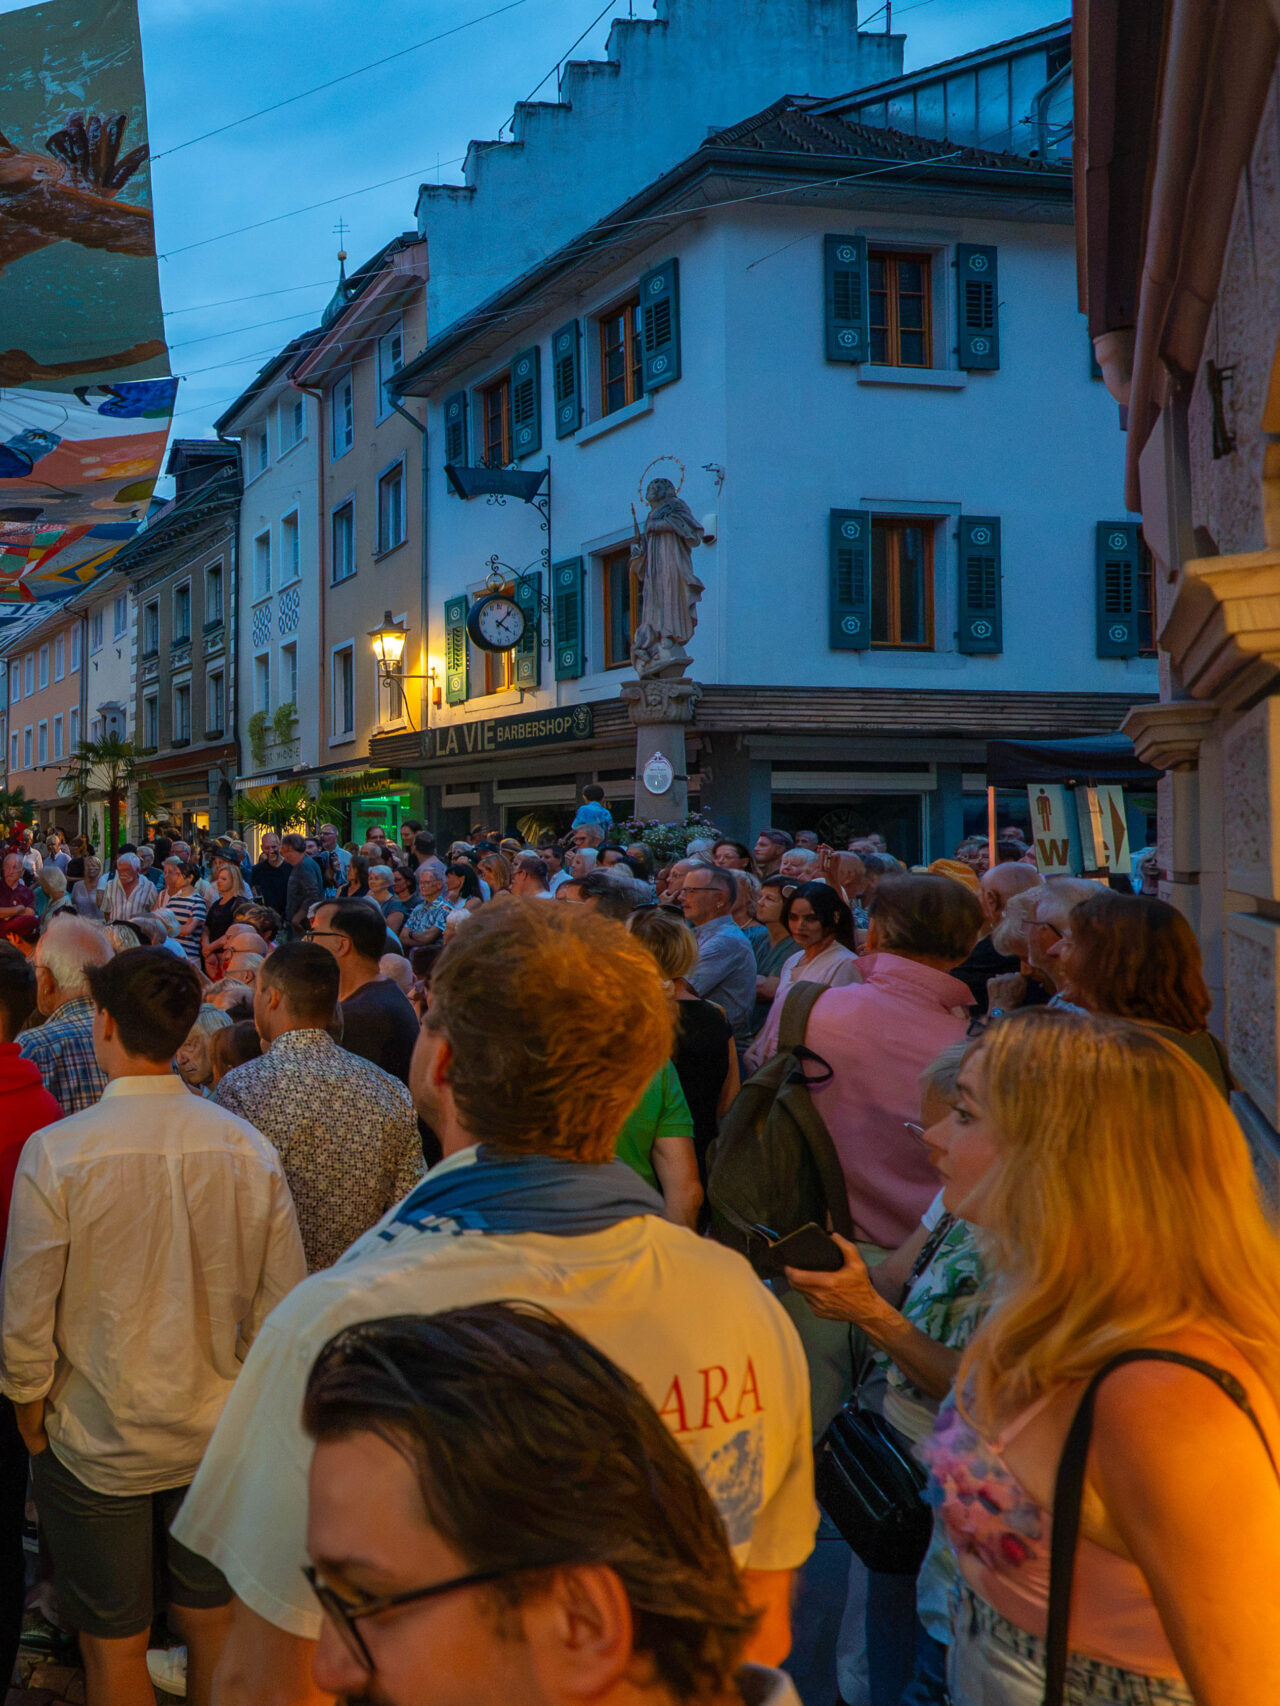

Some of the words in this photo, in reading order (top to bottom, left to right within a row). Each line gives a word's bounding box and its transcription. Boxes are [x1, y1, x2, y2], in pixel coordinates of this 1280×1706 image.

[436, 726, 459, 757] LA
[463, 720, 497, 753] VIE
[497, 716, 572, 742] BARBERSHOP
[658, 1355, 766, 1434] ARA
